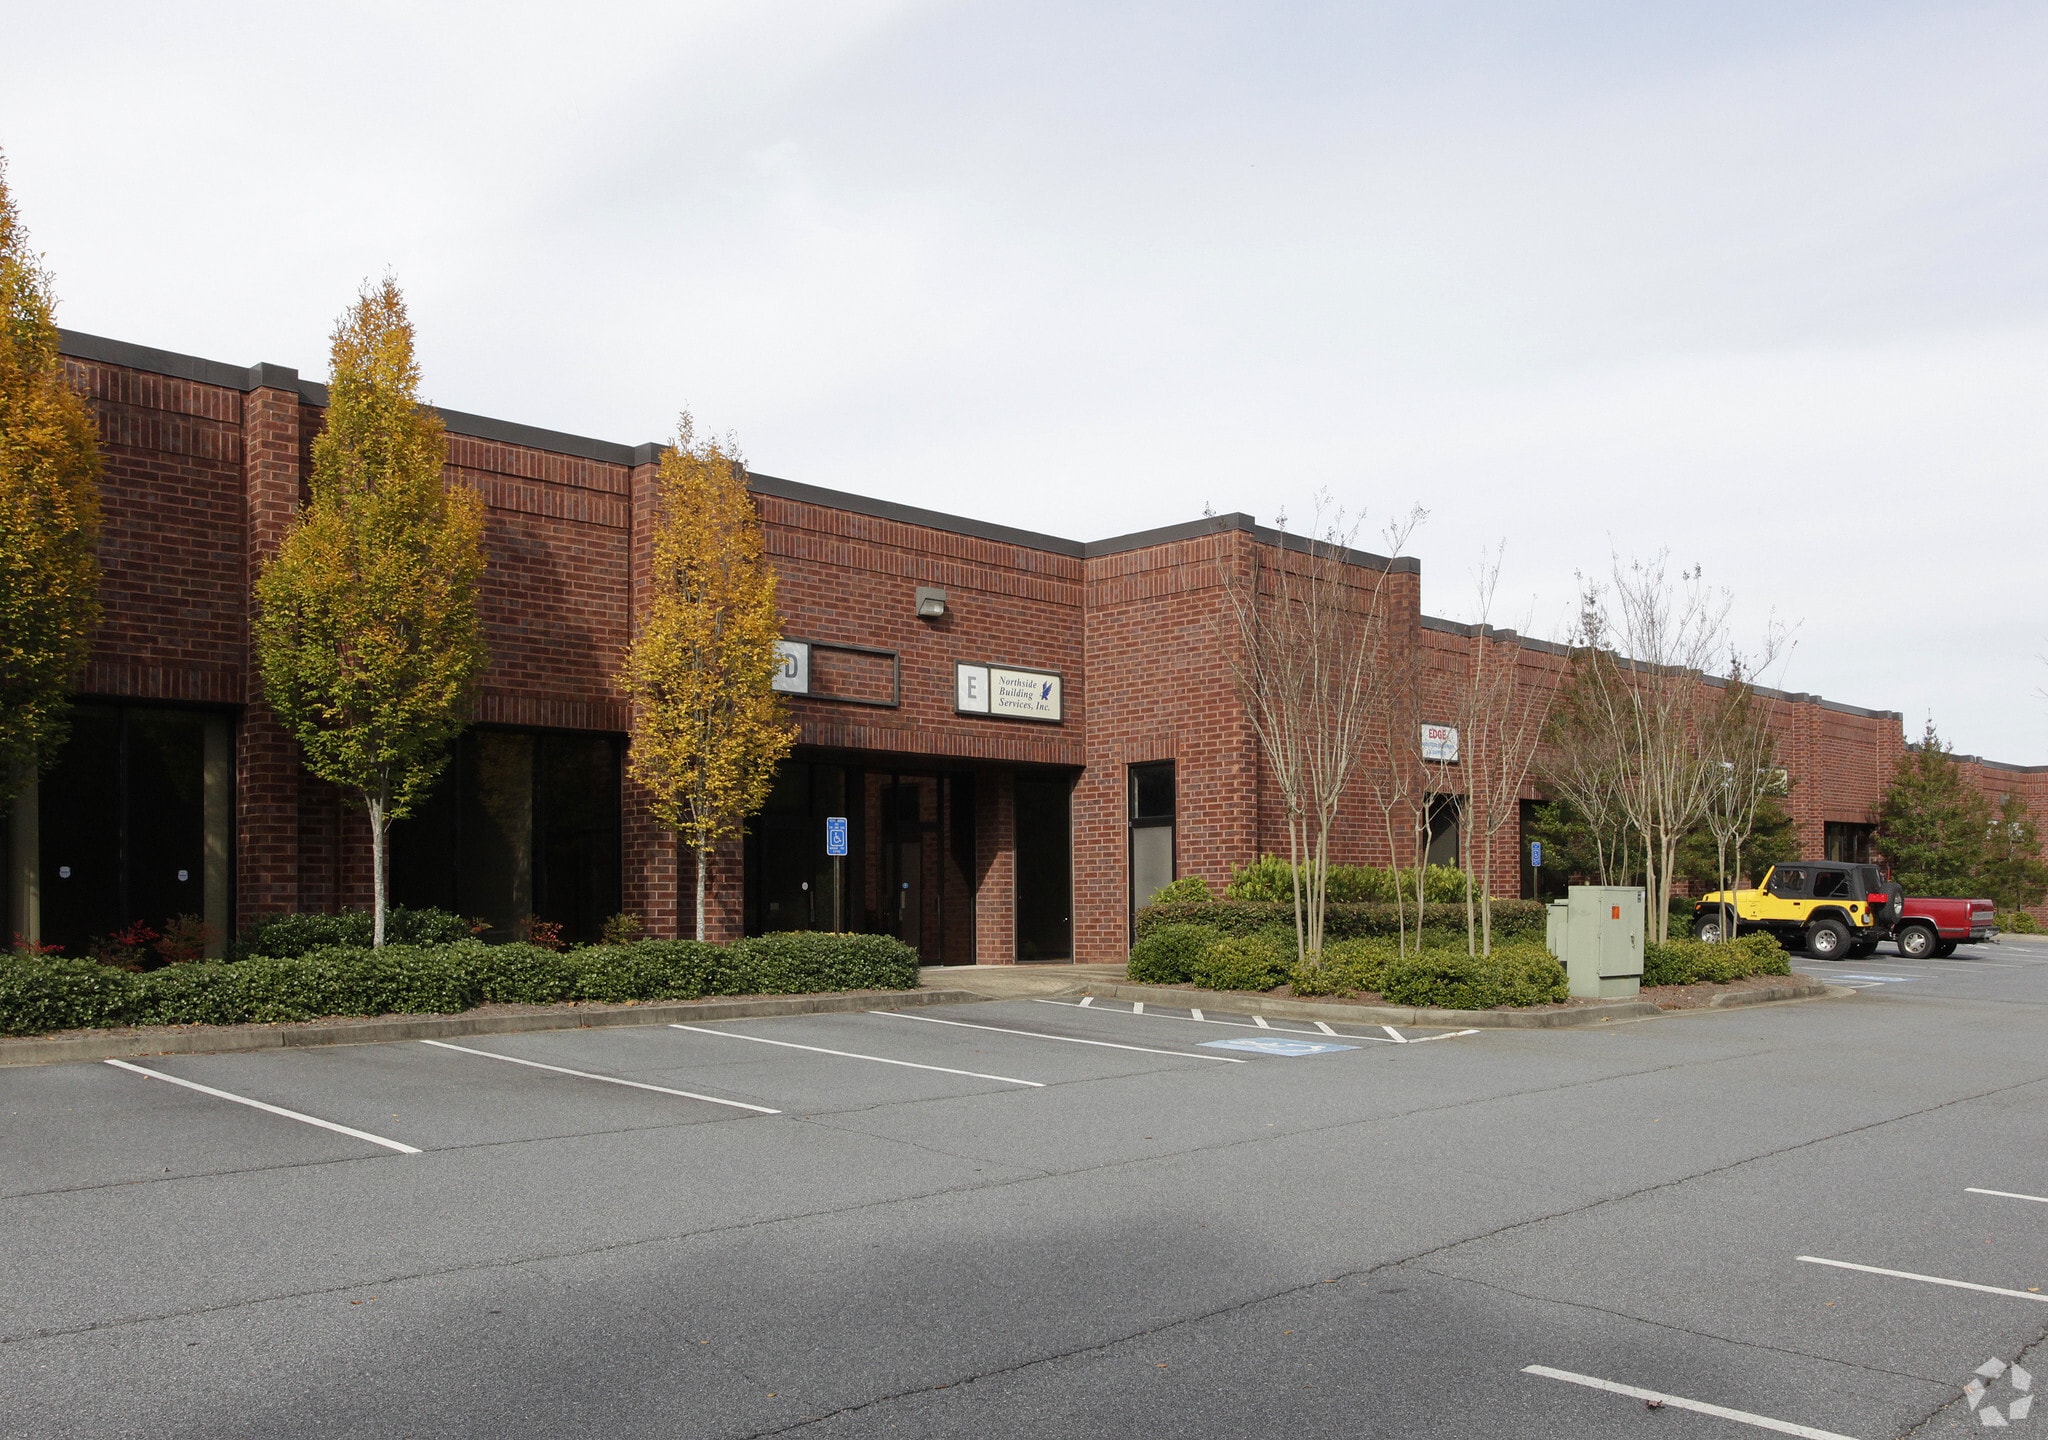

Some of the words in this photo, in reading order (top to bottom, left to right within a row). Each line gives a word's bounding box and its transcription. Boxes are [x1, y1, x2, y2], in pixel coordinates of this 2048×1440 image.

[785, 653, 798, 678] D
[967, 676, 977, 699] E
[998, 676, 1037, 689] Northside
[999, 687, 1033, 700] Building
[998, 698, 1034, 710] Services,
[1036, 701, 1050, 711] Inc.
[1428, 729, 1446, 739] EDGE
